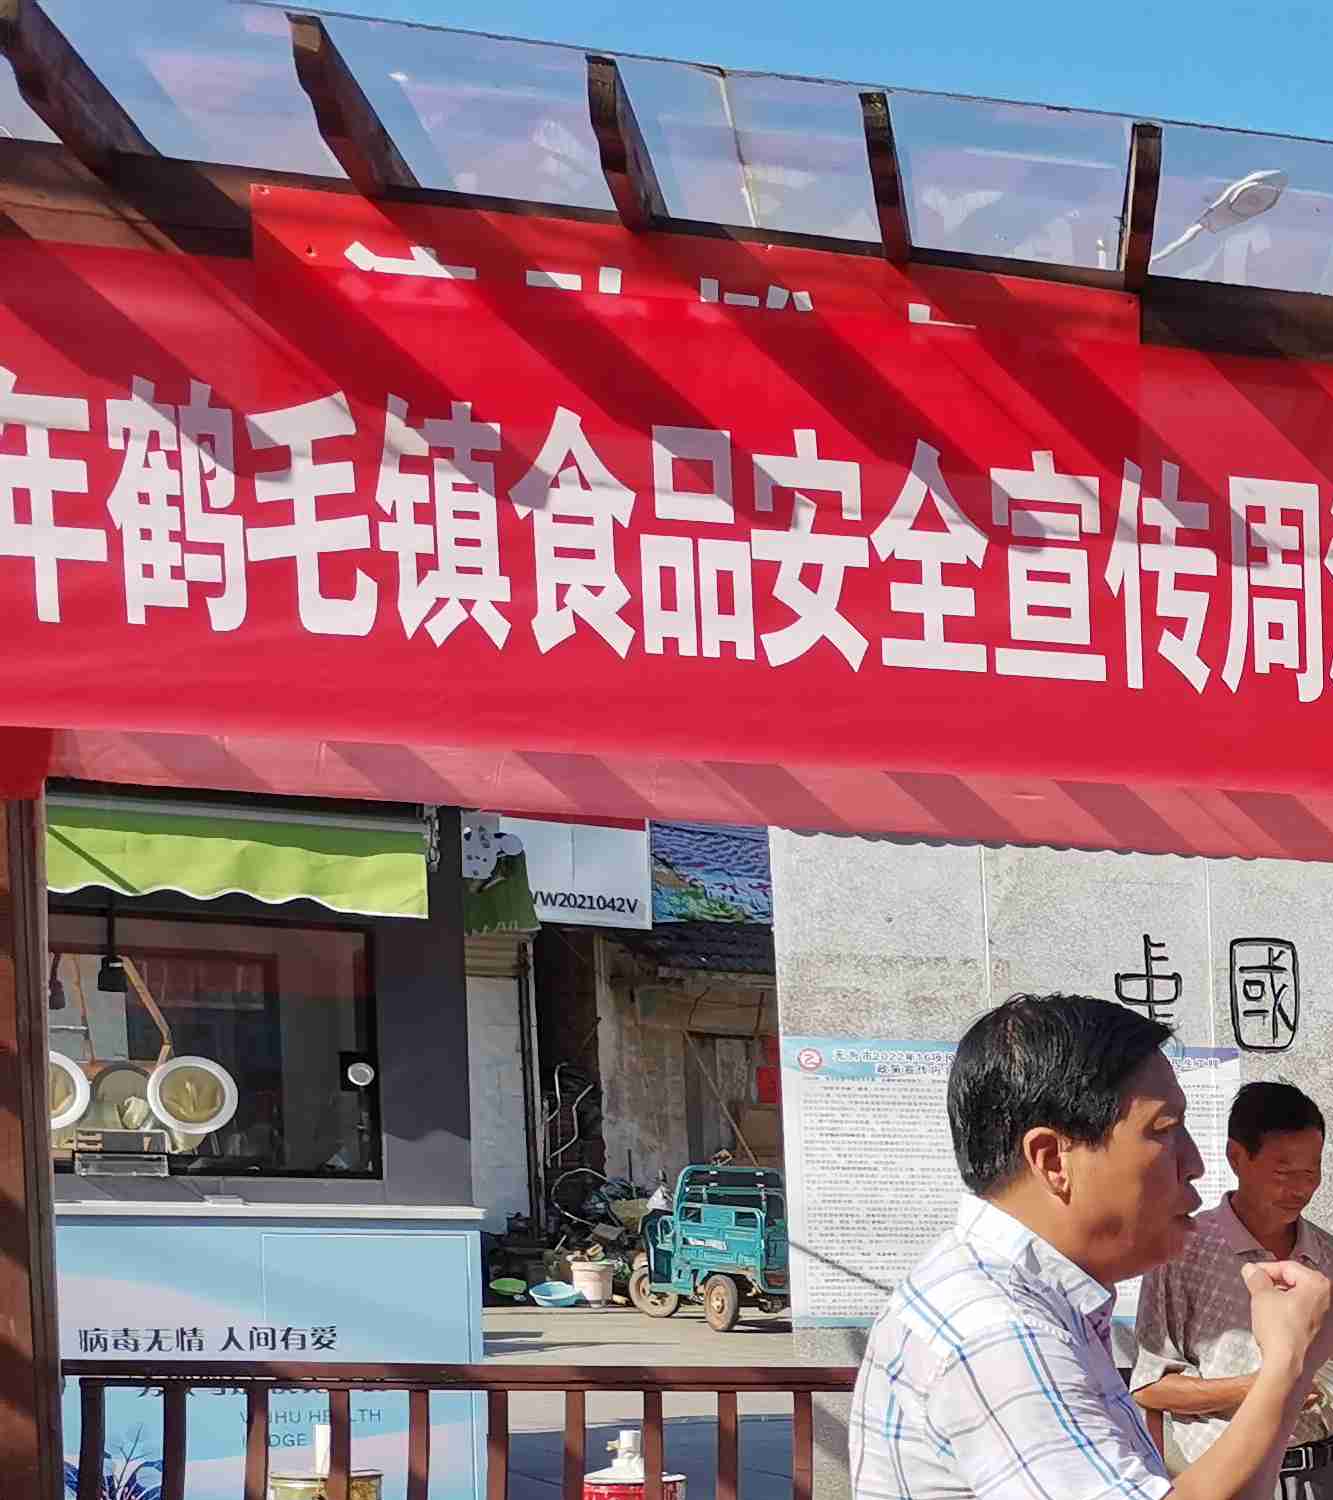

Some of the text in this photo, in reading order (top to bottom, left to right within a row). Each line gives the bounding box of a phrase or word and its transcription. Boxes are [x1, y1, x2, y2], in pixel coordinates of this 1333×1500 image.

[79, 1324, 338, 1353] 病毒无情 人间有爱
[308, 1407, 382, 1424] HELTH
